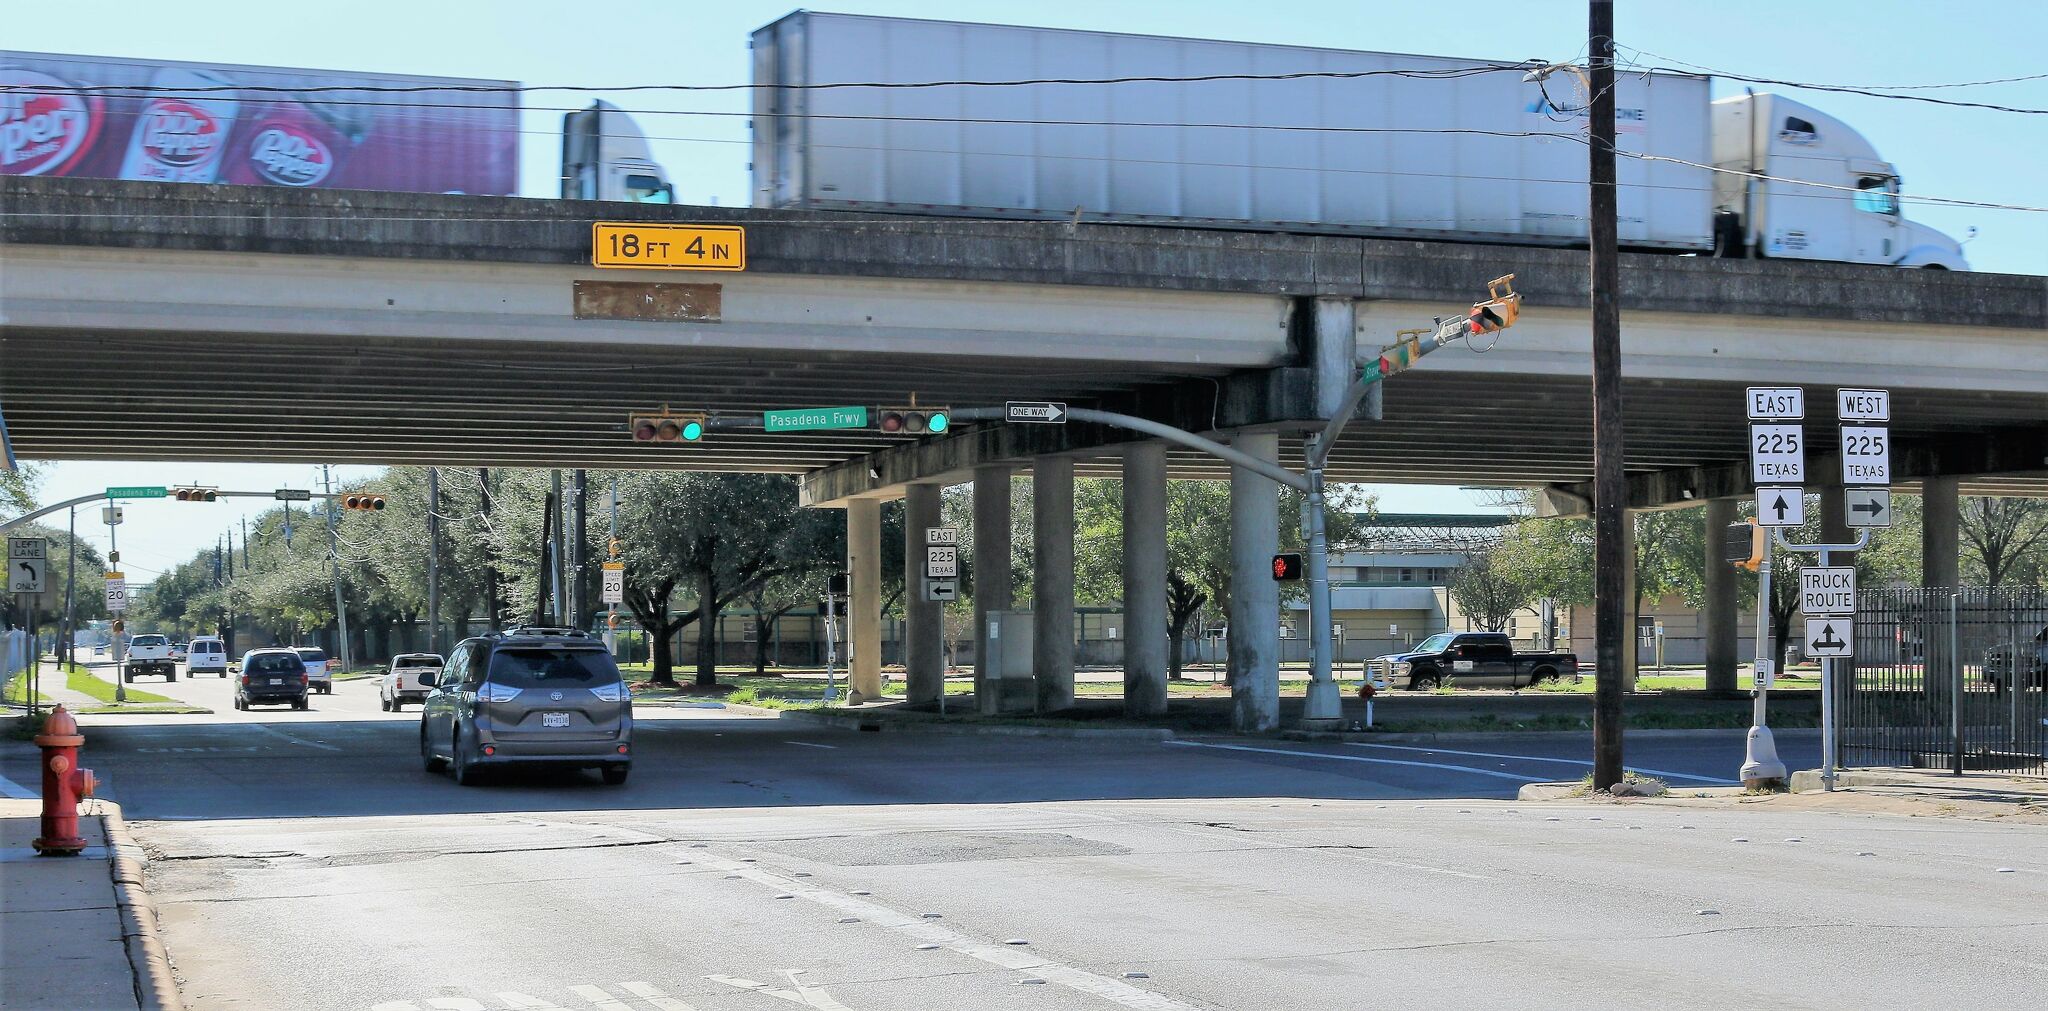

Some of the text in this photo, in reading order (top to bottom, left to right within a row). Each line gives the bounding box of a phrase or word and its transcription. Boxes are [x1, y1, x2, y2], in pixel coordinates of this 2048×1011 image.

[610, 234, 729, 260] 18 FT 4 IN
[1755, 394, 1795, 413] EAST
[1845, 396, 1882, 414] WEST
[1012, 407, 1048, 417] ONE WAY
[770, 412, 860, 427] Pasadena Frwy
[1757, 433, 1798, 454] 225
[1846, 435, 1884, 456] 225
[1759, 463, 1799, 475] TEXAS
[1848, 465, 1884, 477] TEXAS
[930, 530, 953, 542] EAST
[14, 549, 40, 557] LANE
[930, 551, 954, 562] 225
[931, 566, 954, 574] TEXAS
[15, 582, 38, 590] ONLY
[605, 582, 621, 592] 20
[1803, 574, 1851, 589] TRUCK
[108, 590, 124, 600] 20
[1806, 593, 1852, 607] ROUTE
